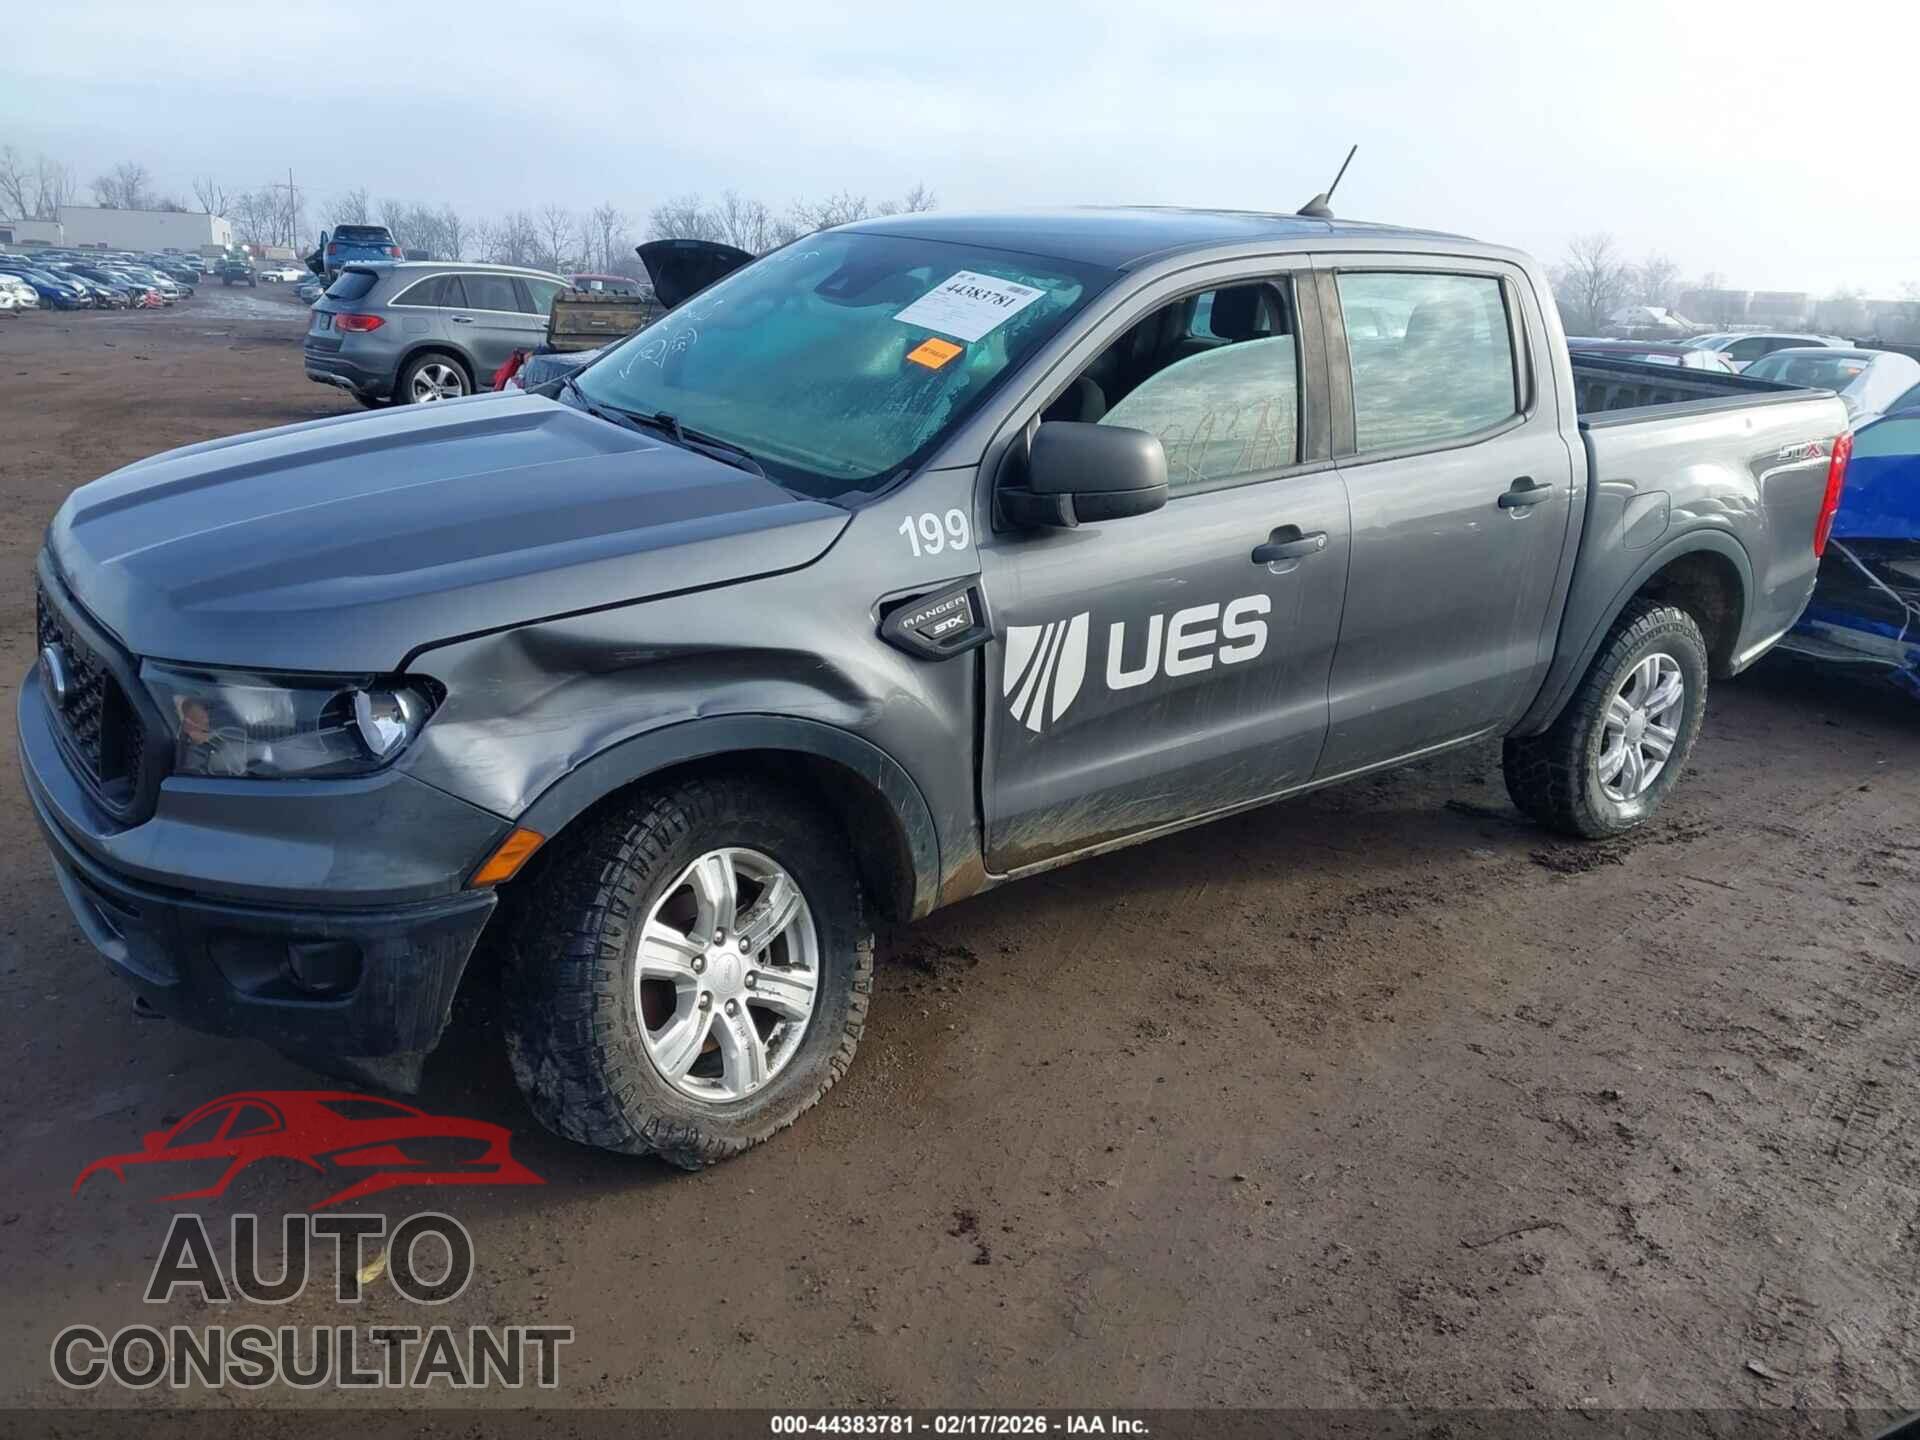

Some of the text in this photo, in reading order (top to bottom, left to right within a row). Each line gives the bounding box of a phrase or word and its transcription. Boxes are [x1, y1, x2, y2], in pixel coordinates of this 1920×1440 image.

[946, 283, 1017, 308] 44383781
[898, 509, 970, 557] 199
[903, 596, 966, 628] RANGER
[934, 614, 966, 634] STX
[1106, 594, 1271, 690] UES
